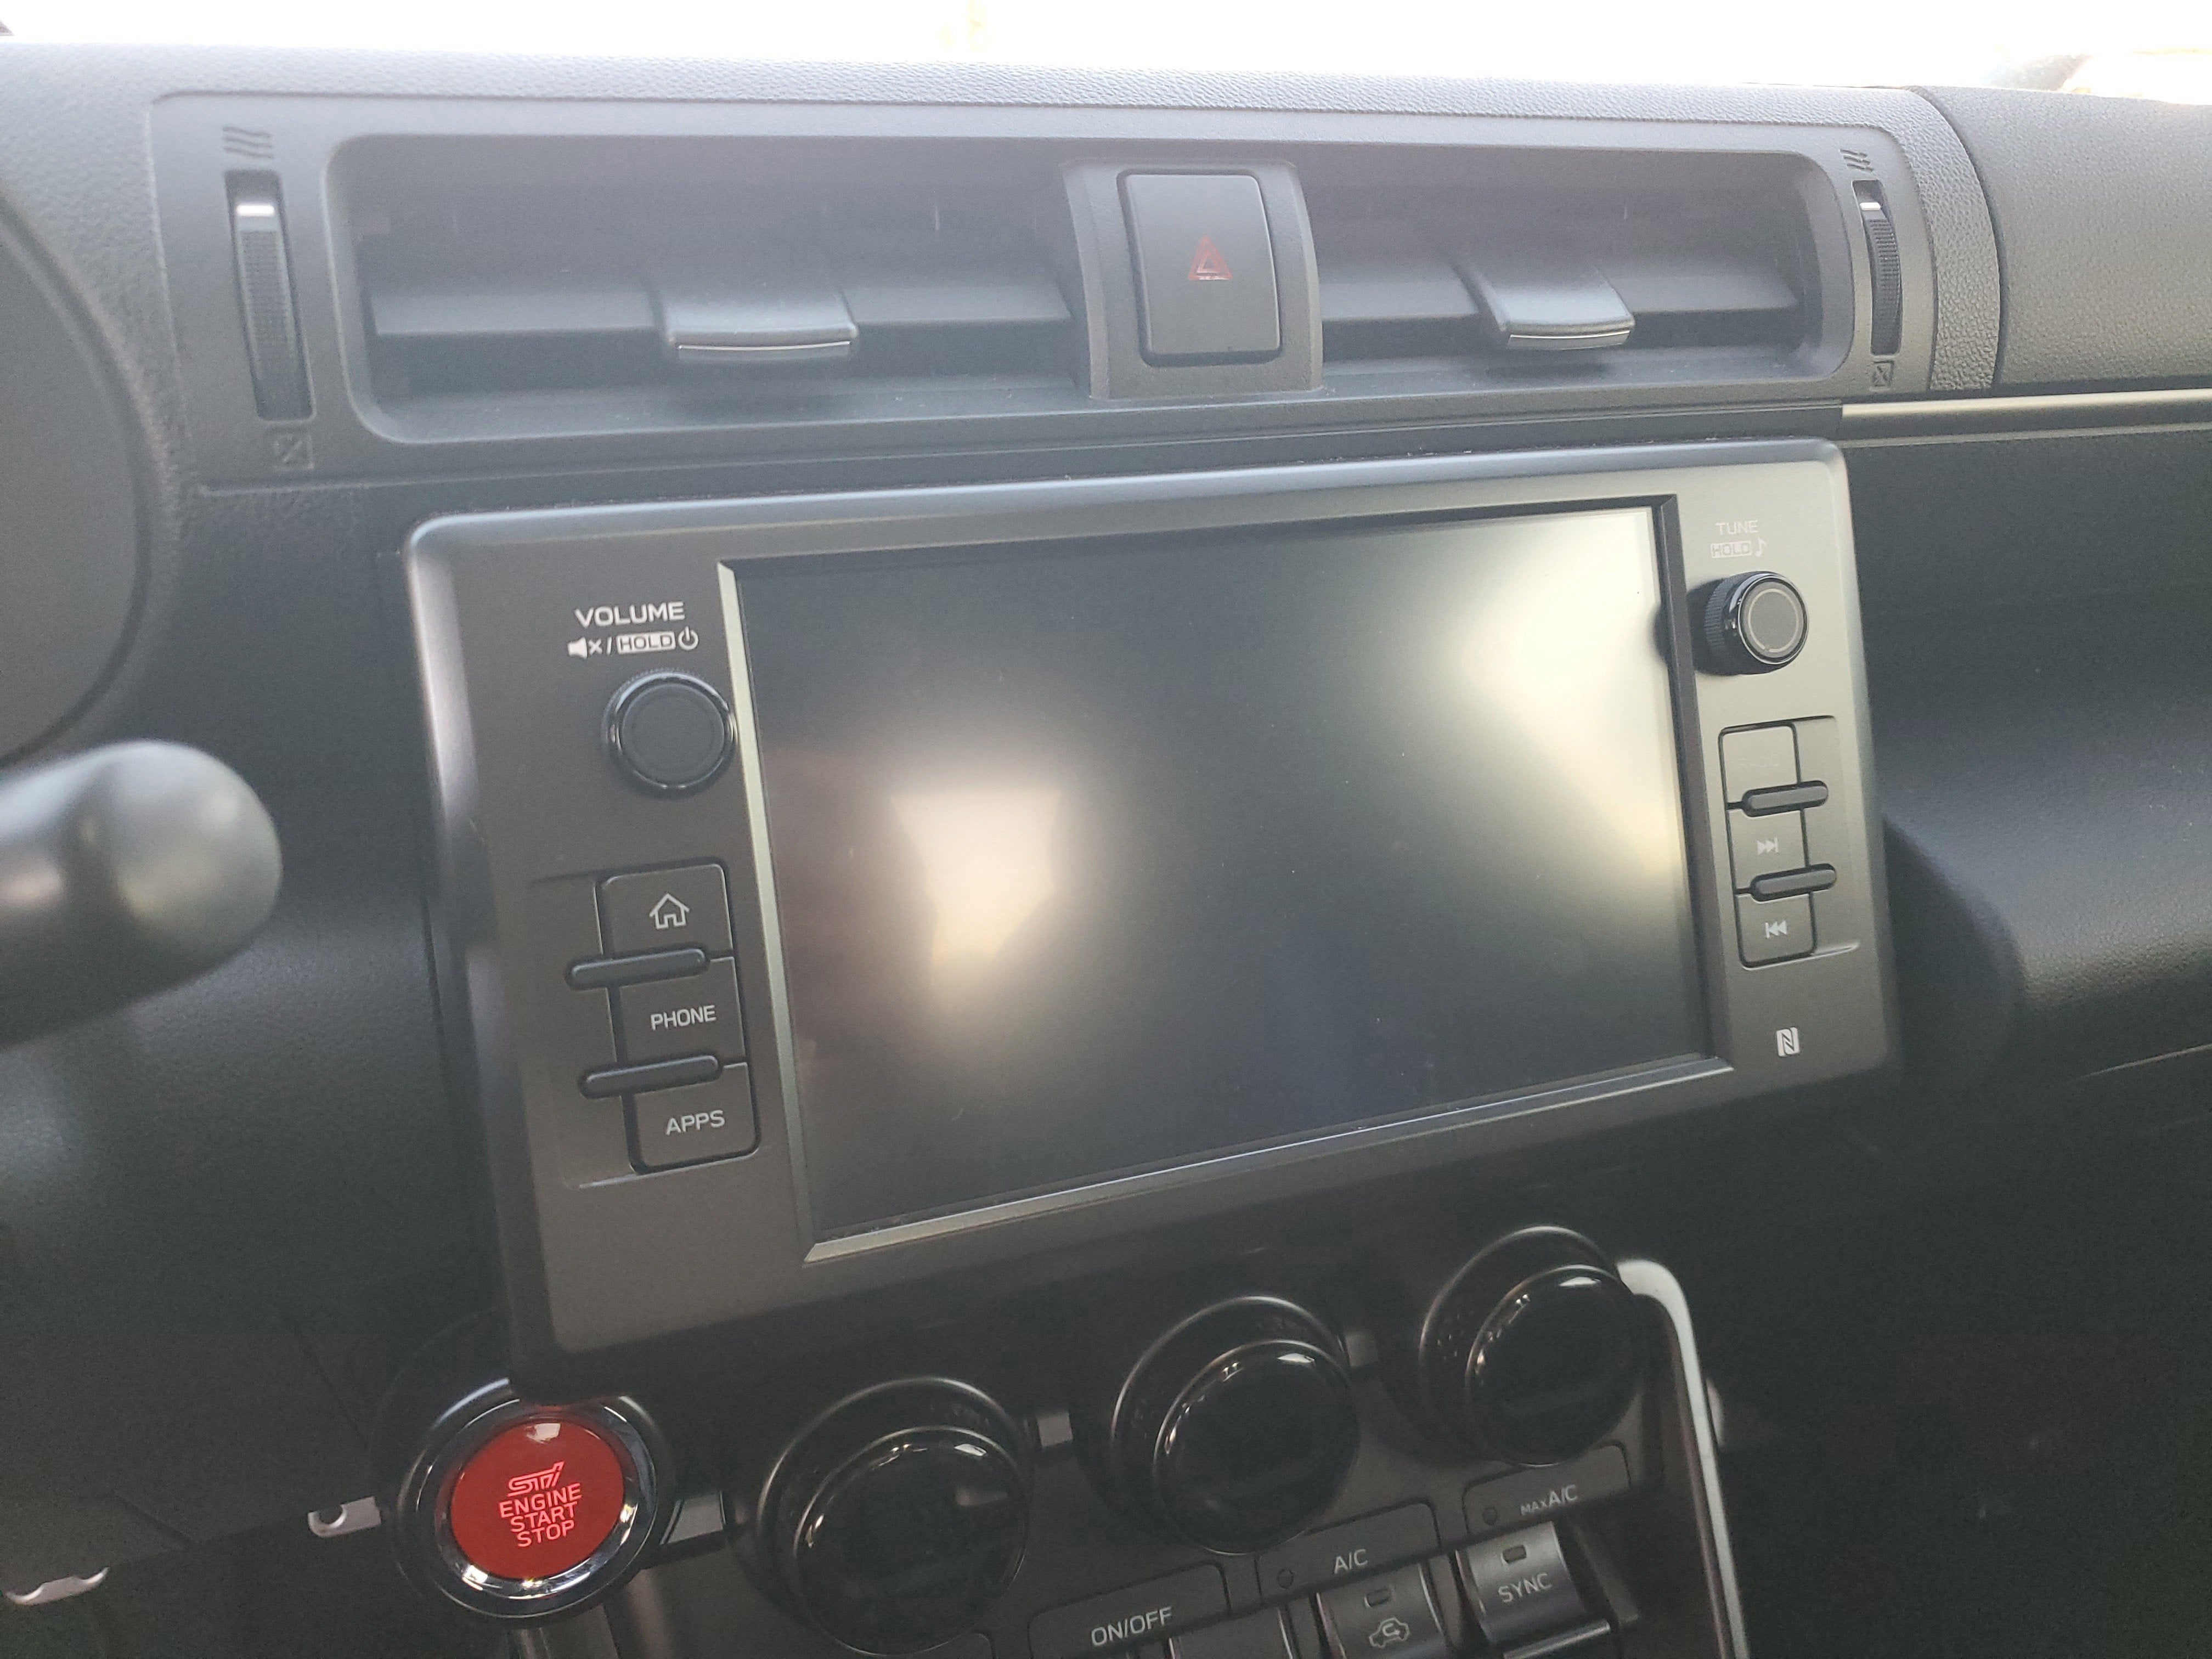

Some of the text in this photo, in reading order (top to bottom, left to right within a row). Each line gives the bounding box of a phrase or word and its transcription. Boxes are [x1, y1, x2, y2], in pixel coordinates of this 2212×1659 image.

[1715, 520, 1758, 535] TUNE
[574, 601, 685, 628] VOLUME
[618, 632, 674, 653] HOLD
[651, 1005, 716, 1030] PHONE
[665, 1109, 726, 1136] APPS
[499, 1482, 582, 1518] ENGINE
[1549, 1484, 1578, 1507] A/C
[511, 1501, 578, 1532] START
[516, 1520, 575, 1547] STOP
[1334, 1548, 1369, 1574] A/C
[1498, 1572, 1552, 1603] SYNC
[1091, 1606, 1172, 1646] ON/OFF
